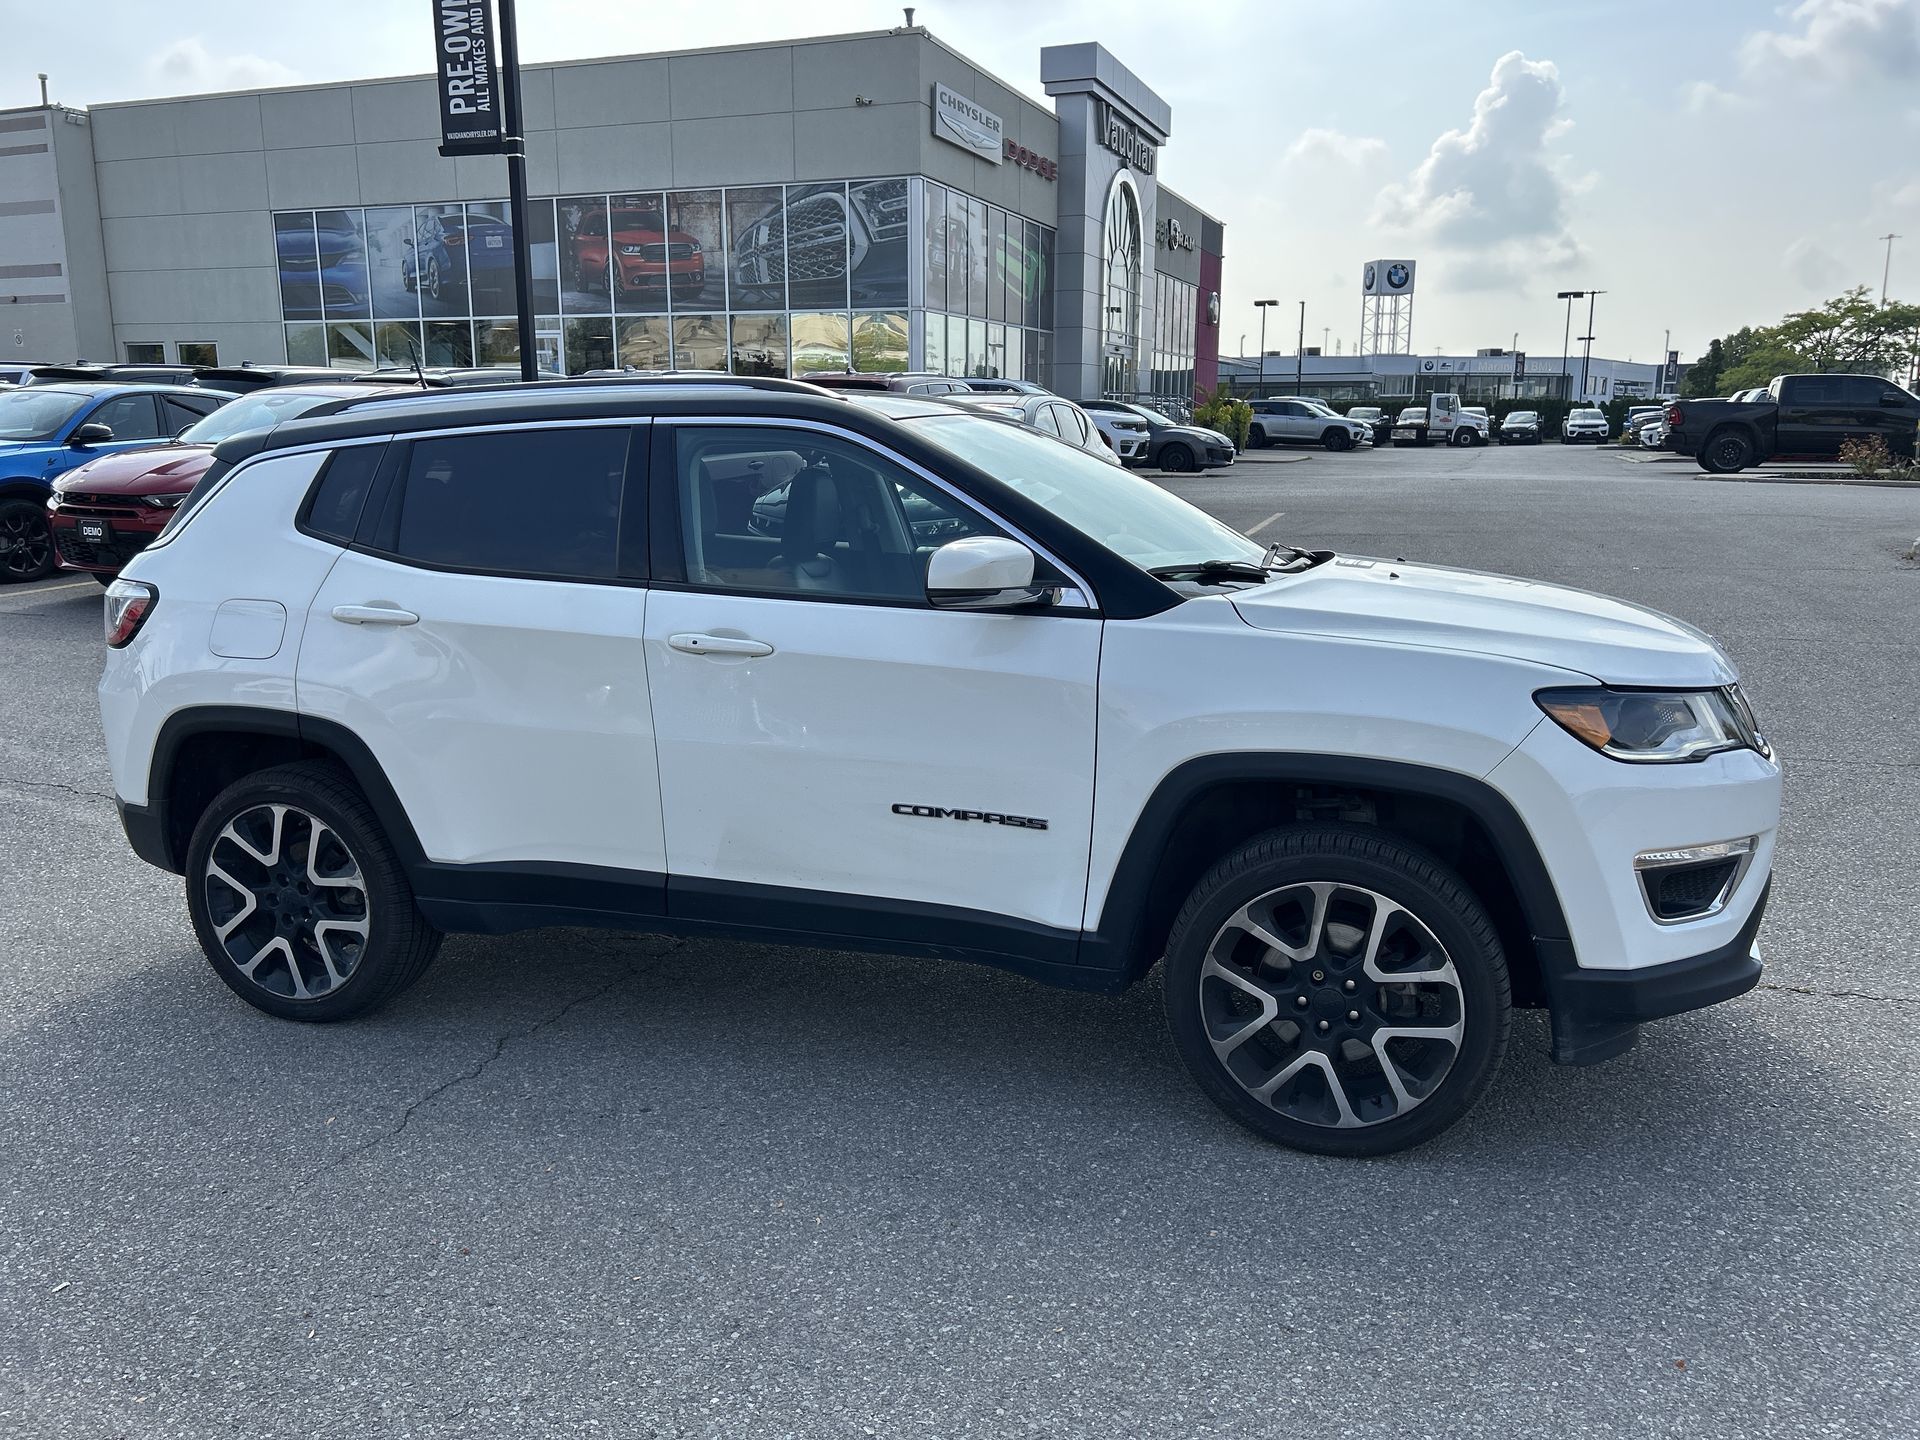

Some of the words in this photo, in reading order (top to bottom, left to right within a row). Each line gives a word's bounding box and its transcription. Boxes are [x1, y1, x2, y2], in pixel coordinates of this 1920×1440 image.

[470, 7, 485, 35] AND
[472, 38, 489, 85] MAKES
[476, 88, 491, 112] ALL
[939, 91, 1000, 133] CHRYSLER
[1100, 101, 1156, 175] Vaughan
[1005, 138, 1058, 182] DODGE
[83, 526, 103, 537] DEMO
[891, 803, 1049, 831] COMPASS
